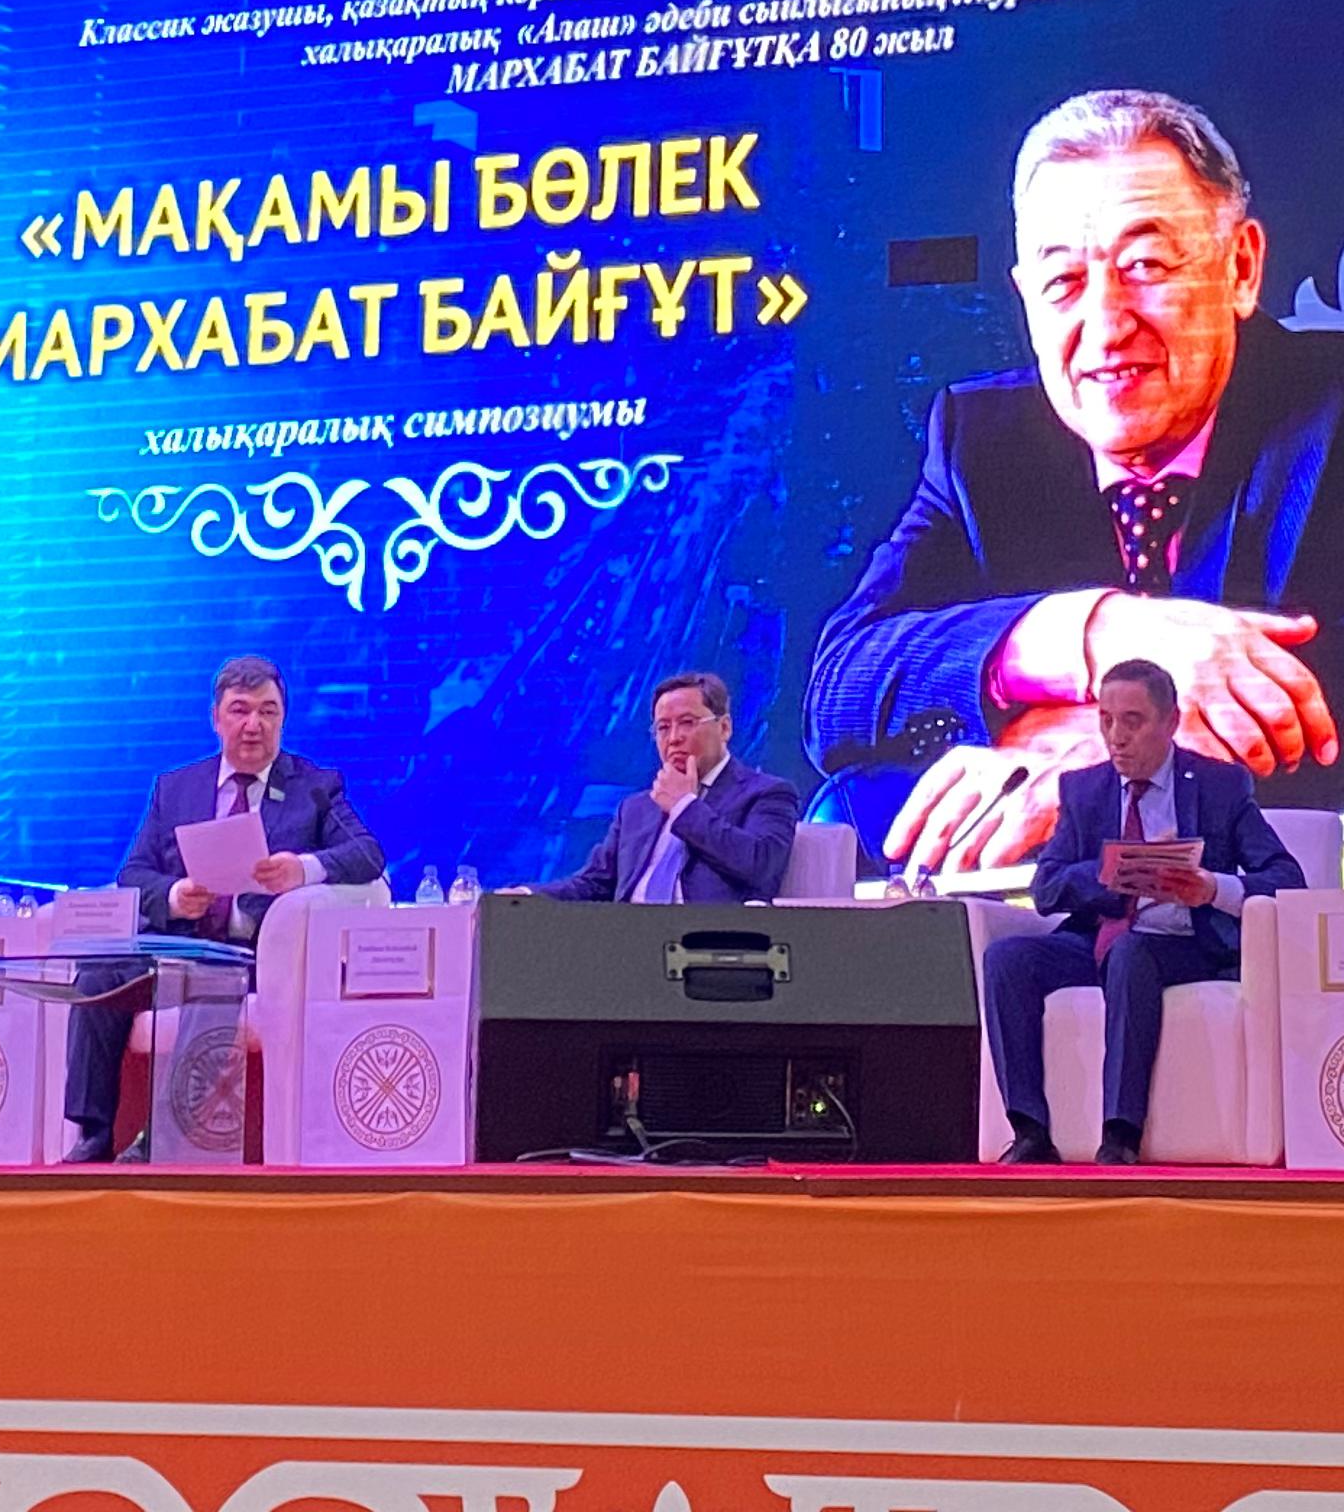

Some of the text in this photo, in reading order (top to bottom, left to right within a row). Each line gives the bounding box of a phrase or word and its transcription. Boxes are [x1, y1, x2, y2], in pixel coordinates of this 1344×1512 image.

[79, 15, 197, 47] Классик
[200, 1, 334, 38] жазушы,
[301, 24, 502, 66] халықаралық
[517, 11, 636, 46] «Алаш»
[446, 25, 955, 94] МАРХАБАТ БАЙҒҰТҚА 80 жыл
[20, 132, 761, 262] «МАҚАМЫ БӨЛЕК
[418, 248, 810, 354] БАЙҒҰТ»
[138, 396, 648, 458] халықаралық симпозиумы
